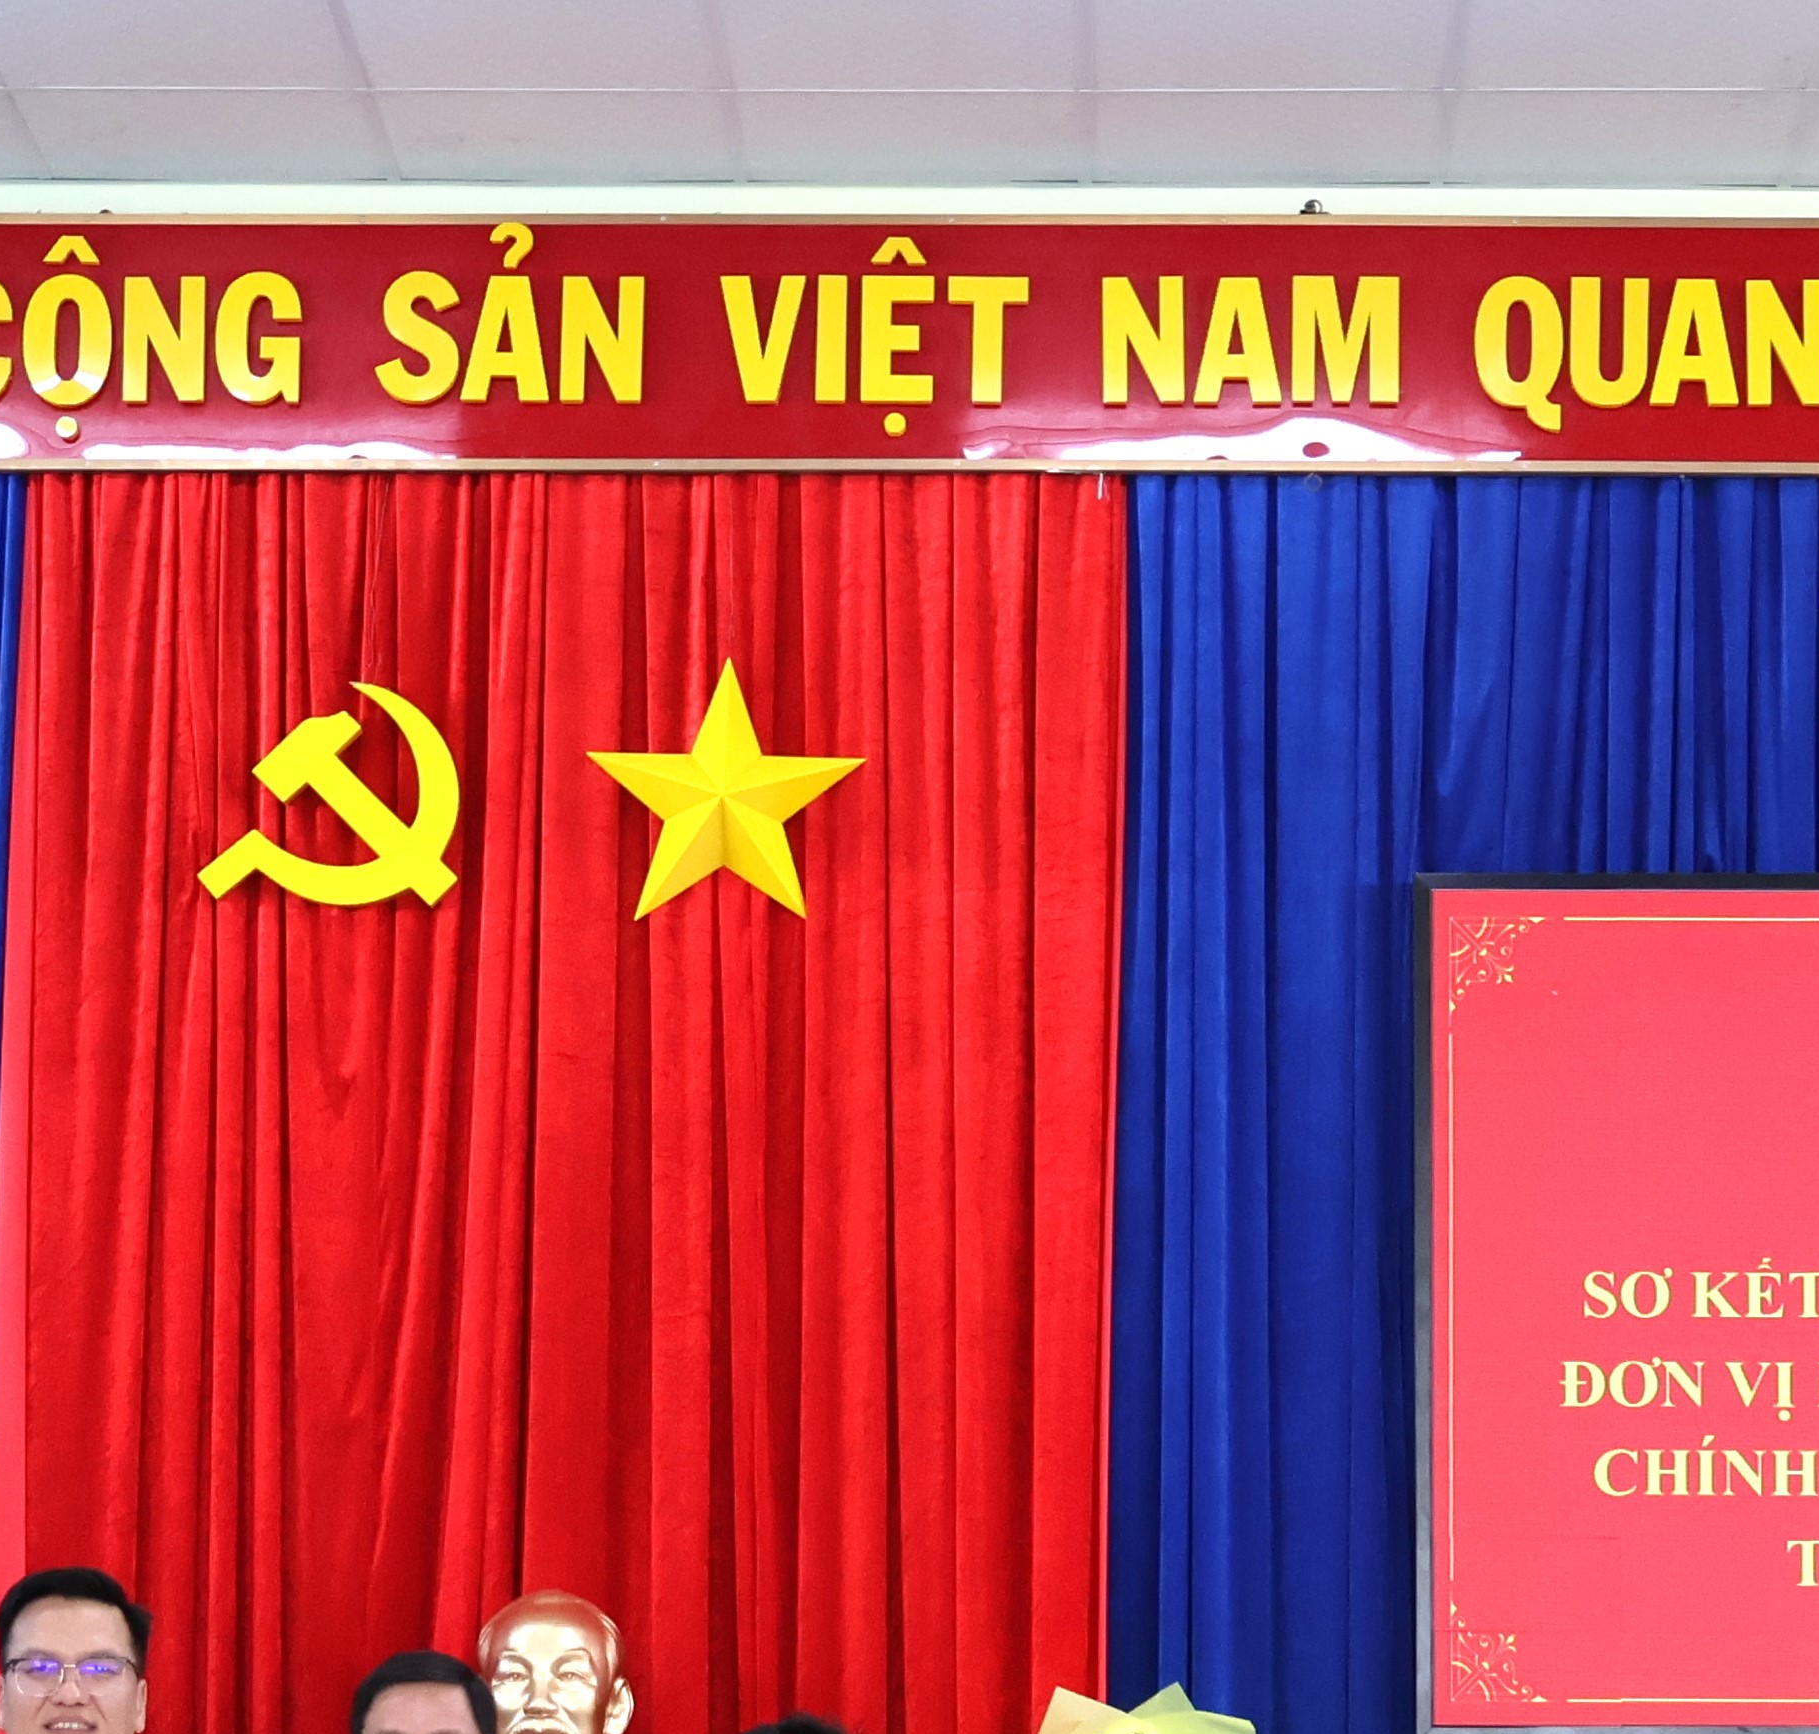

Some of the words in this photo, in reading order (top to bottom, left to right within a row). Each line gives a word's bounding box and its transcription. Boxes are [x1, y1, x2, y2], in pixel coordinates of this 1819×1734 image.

[374, 220, 646, 405] SẢN
[719, 236, 1031, 438] VIỆT
[1101, 275, 1402, 407] NAM
[1583, 1268, 1674, 1319] SƠ
[1559, 1356, 1705, 1408] ĐƠN
[1725, 1361, 1796, 1422] VỊ
[1593, 1434, 1819, 1497] CHÍNH
